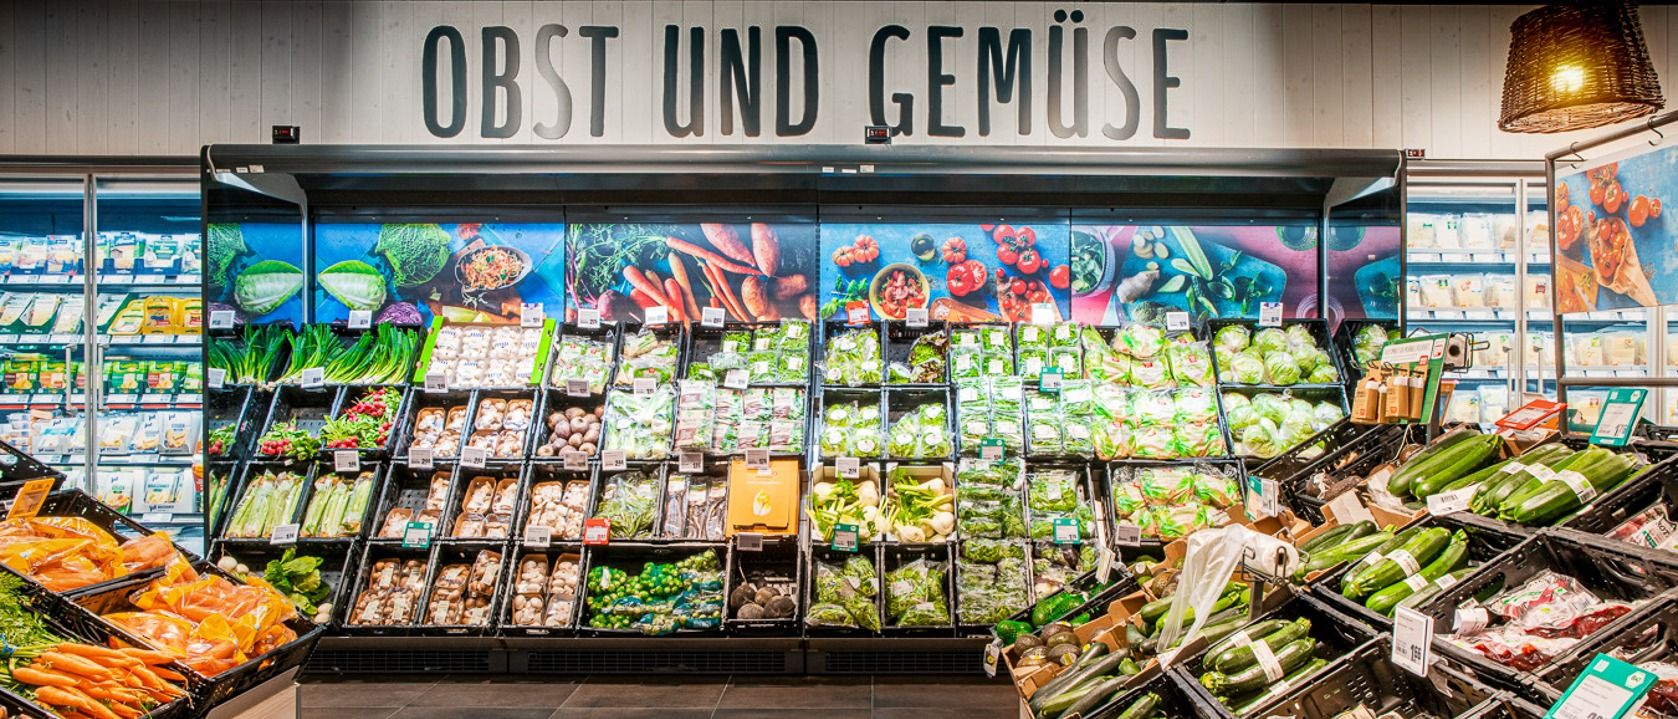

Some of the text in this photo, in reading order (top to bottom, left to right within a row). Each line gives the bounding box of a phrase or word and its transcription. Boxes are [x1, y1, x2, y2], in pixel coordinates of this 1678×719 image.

[422, 9, 1191, 140] OBST UND GEMÜSE
